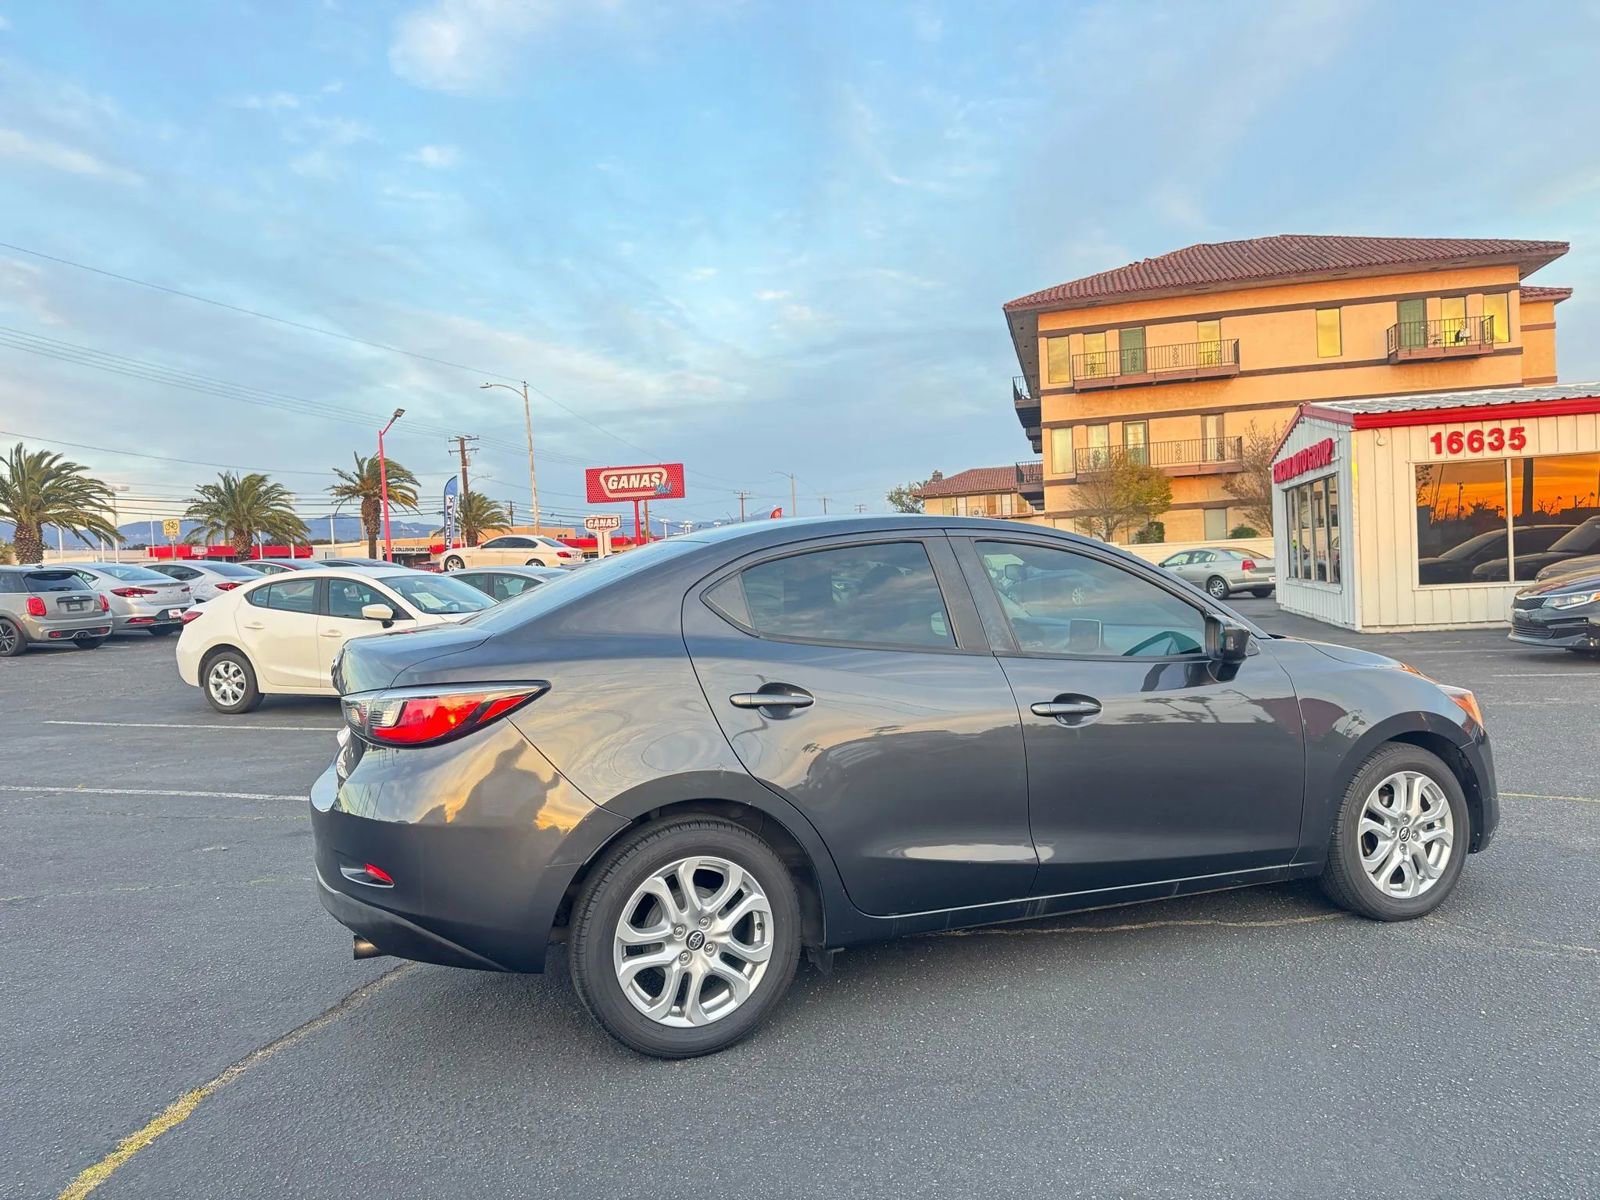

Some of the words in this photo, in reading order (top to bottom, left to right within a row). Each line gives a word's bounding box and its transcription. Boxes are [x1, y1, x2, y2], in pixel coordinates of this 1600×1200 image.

[1430, 427, 1526, 455] 16635
[1308, 438, 1333, 471] GROUP
[608, 473, 661, 490] GANAS
[587, 518, 618, 529] GANAS
